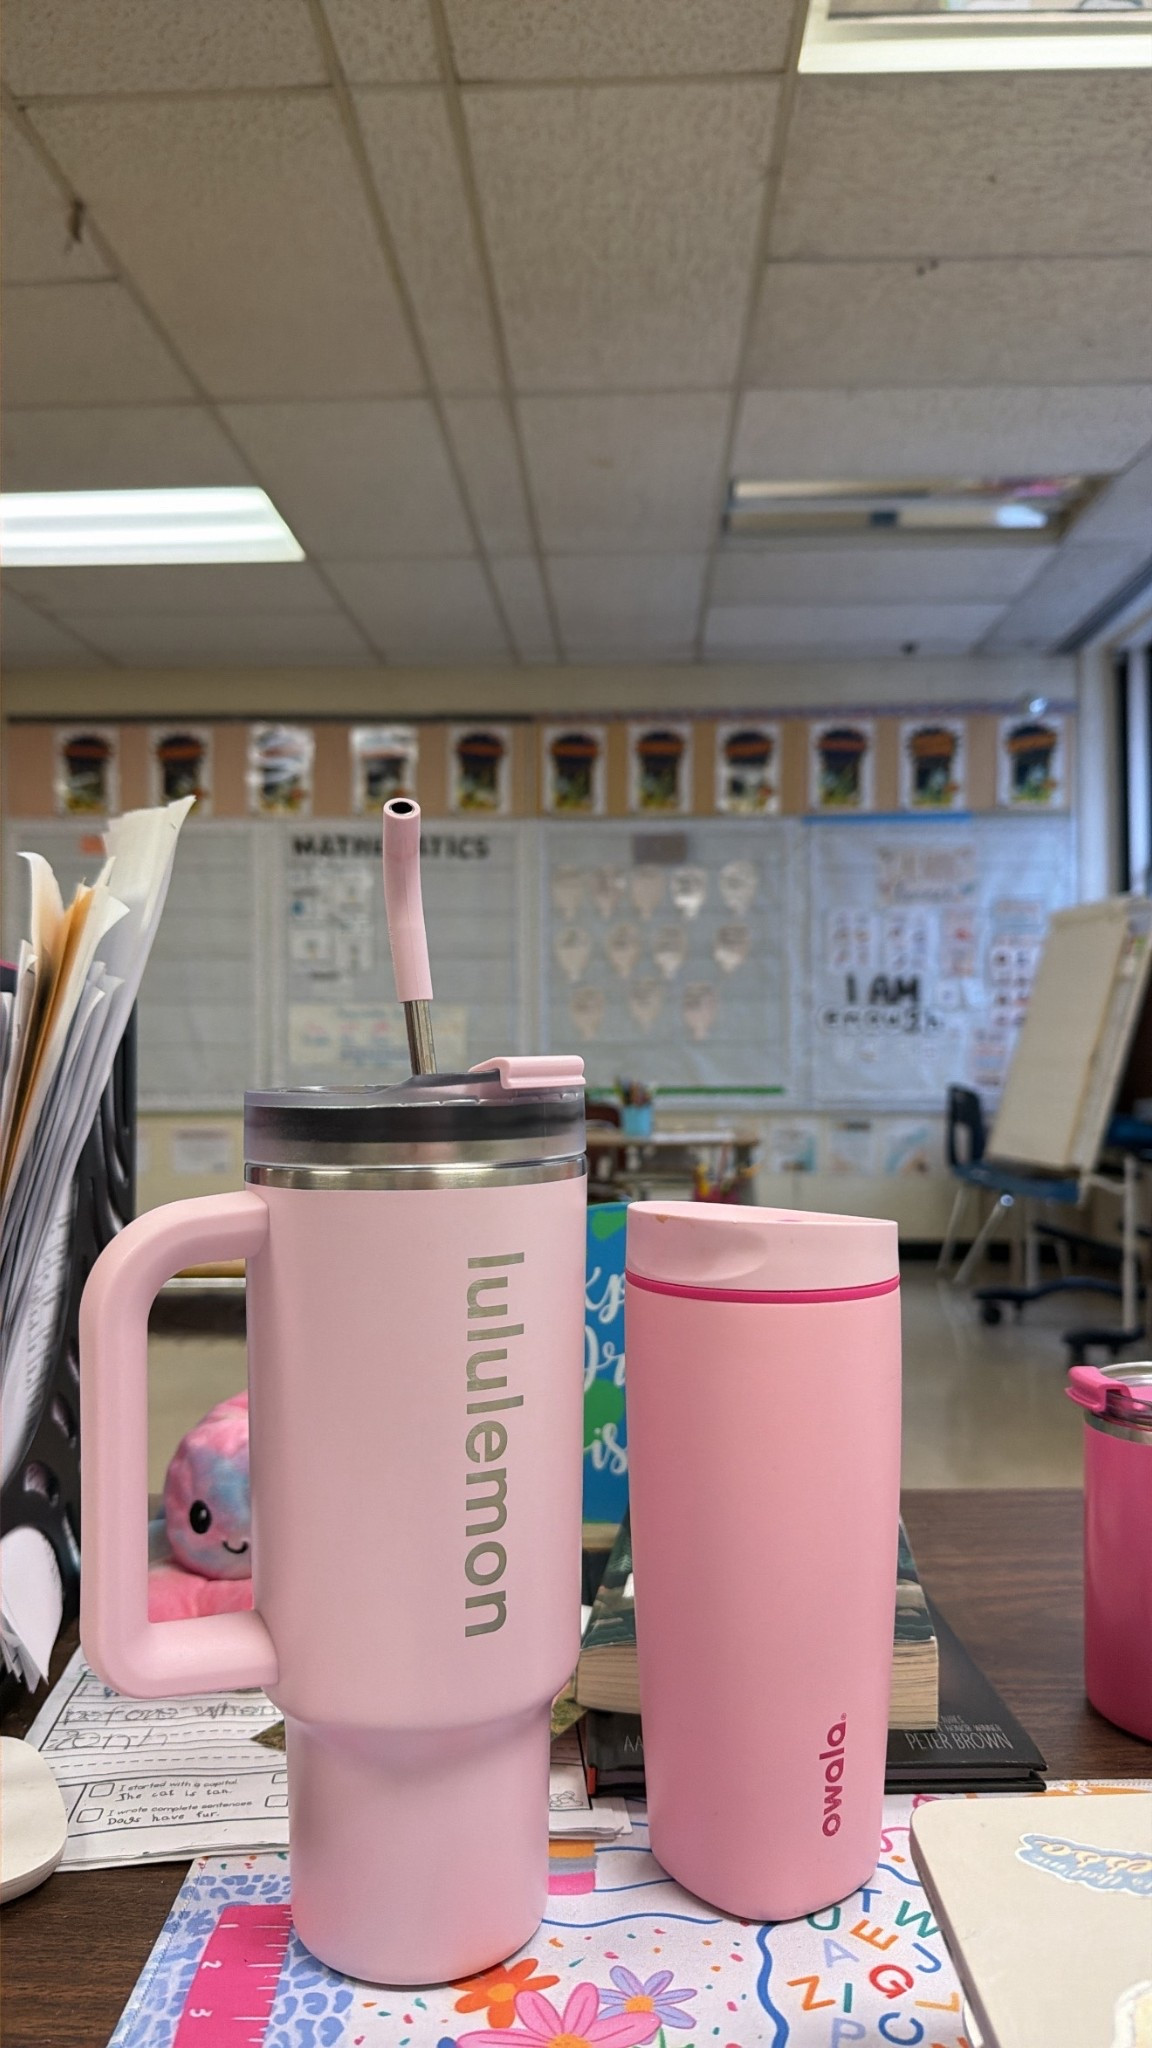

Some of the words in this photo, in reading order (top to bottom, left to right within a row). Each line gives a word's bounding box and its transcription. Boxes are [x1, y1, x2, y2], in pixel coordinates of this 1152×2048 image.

[293, 834, 490, 859] MATHTICS
[846, 974, 857, 1004] I
[869, 973, 920, 1006] AM
[465, 1252, 525, 1637] lululemon
[904, 1733, 952, 1750] PETER
[951, 1733, 1014, 1750] BROWN
[152, 1790, 174, 1798] cat
[169, 1780, 191, 1788] with
[818, 1721, 847, 1837] owala
[117, 1806, 148, 1816] wrote
[151, 1803, 199, 1814] complete
[151, 1813, 185, 1823] have
[858, 1888, 882, 1913] T
[850, 1919, 899, 1950] E
[823, 1938, 860, 1968] A
[912, 1942, 942, 1974] J
[831, 2017, 866, 2048] P
[878, 2012, 924, 2046] C
